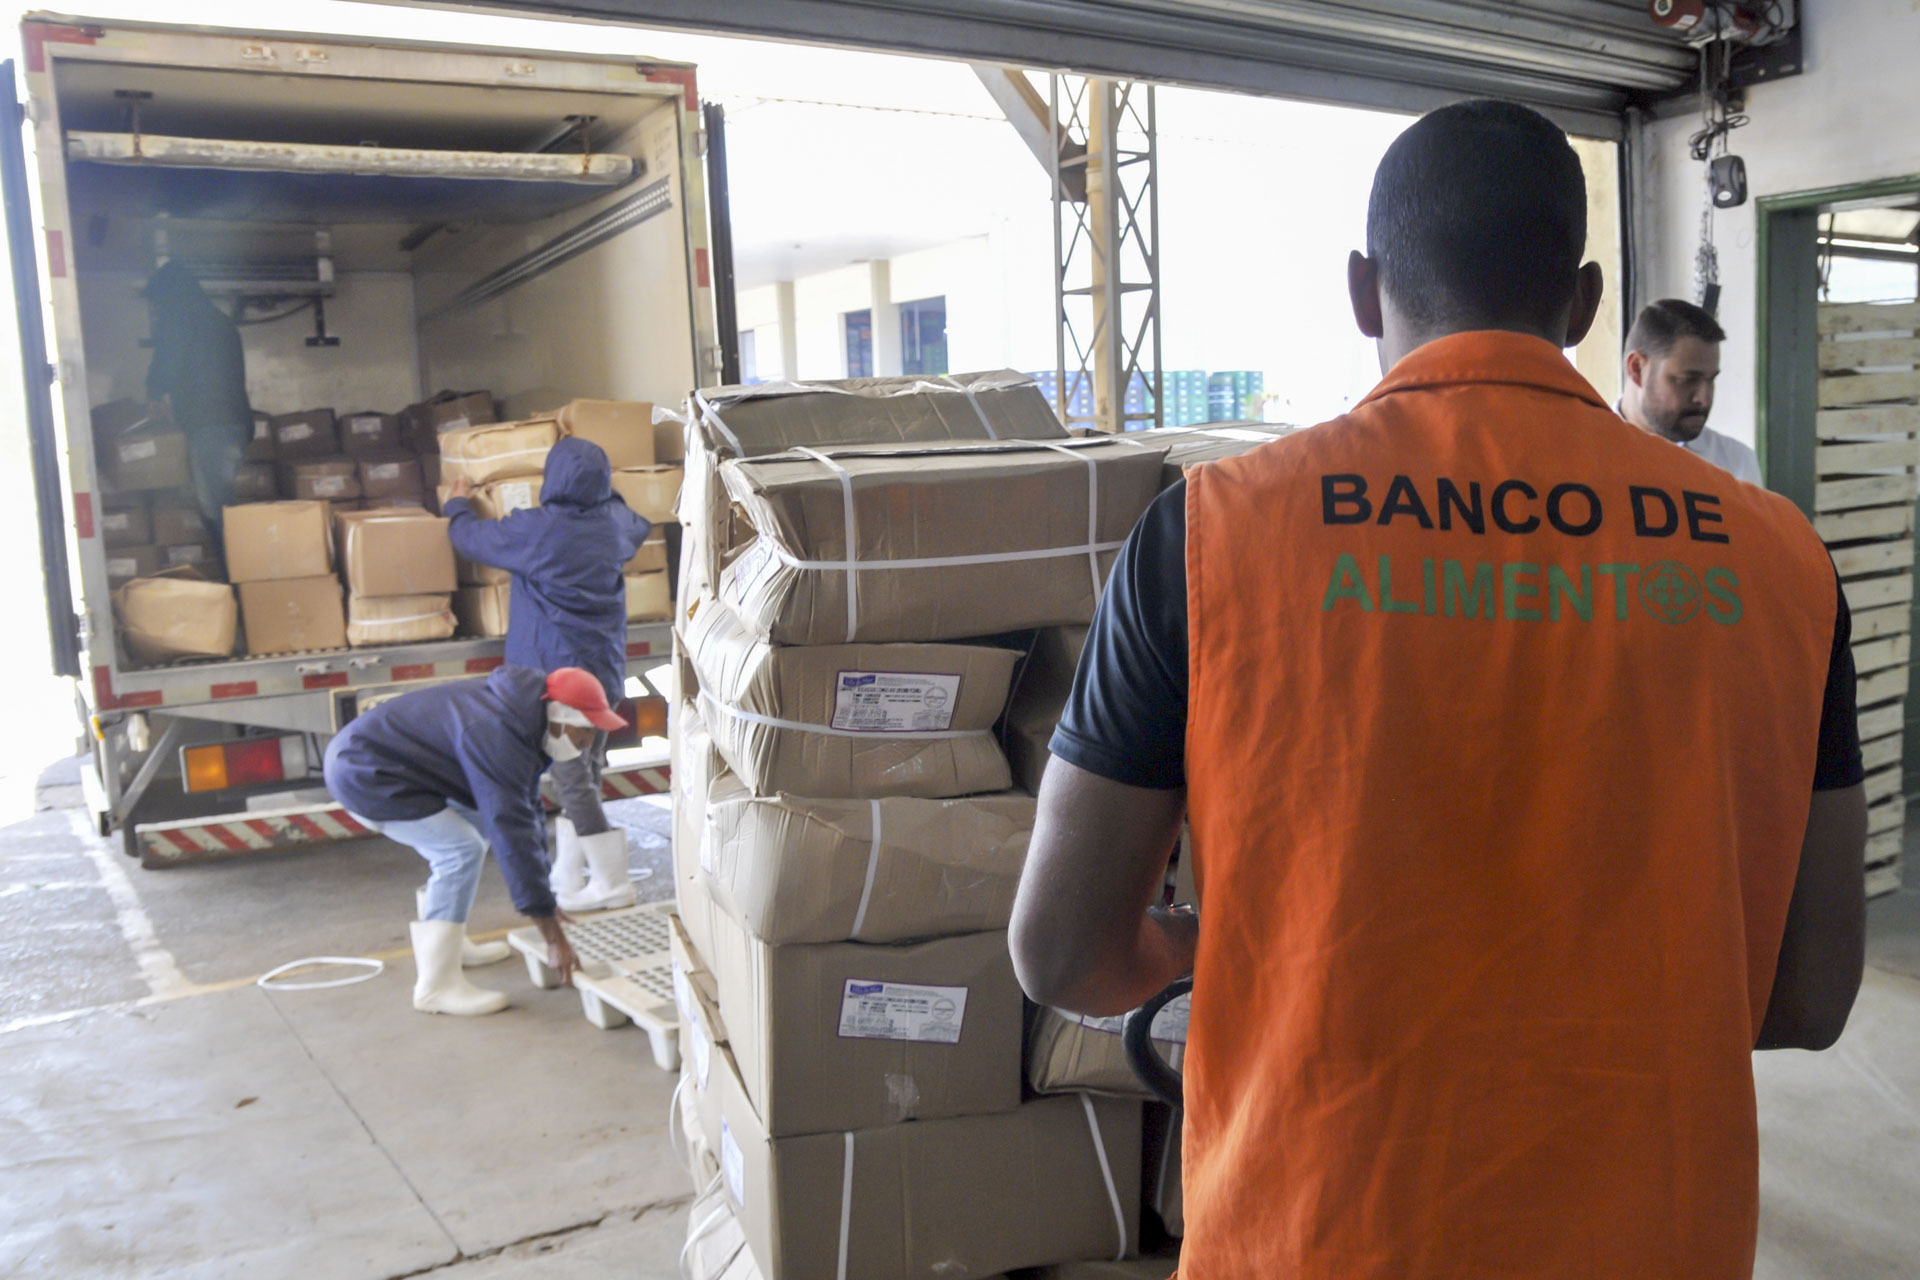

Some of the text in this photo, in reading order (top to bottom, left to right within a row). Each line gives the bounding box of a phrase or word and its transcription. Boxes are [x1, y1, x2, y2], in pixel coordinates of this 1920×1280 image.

[1320, 473, 1731, 545] BANCO DE
[1320, 552, 1744, 626] ALIMENTOS
